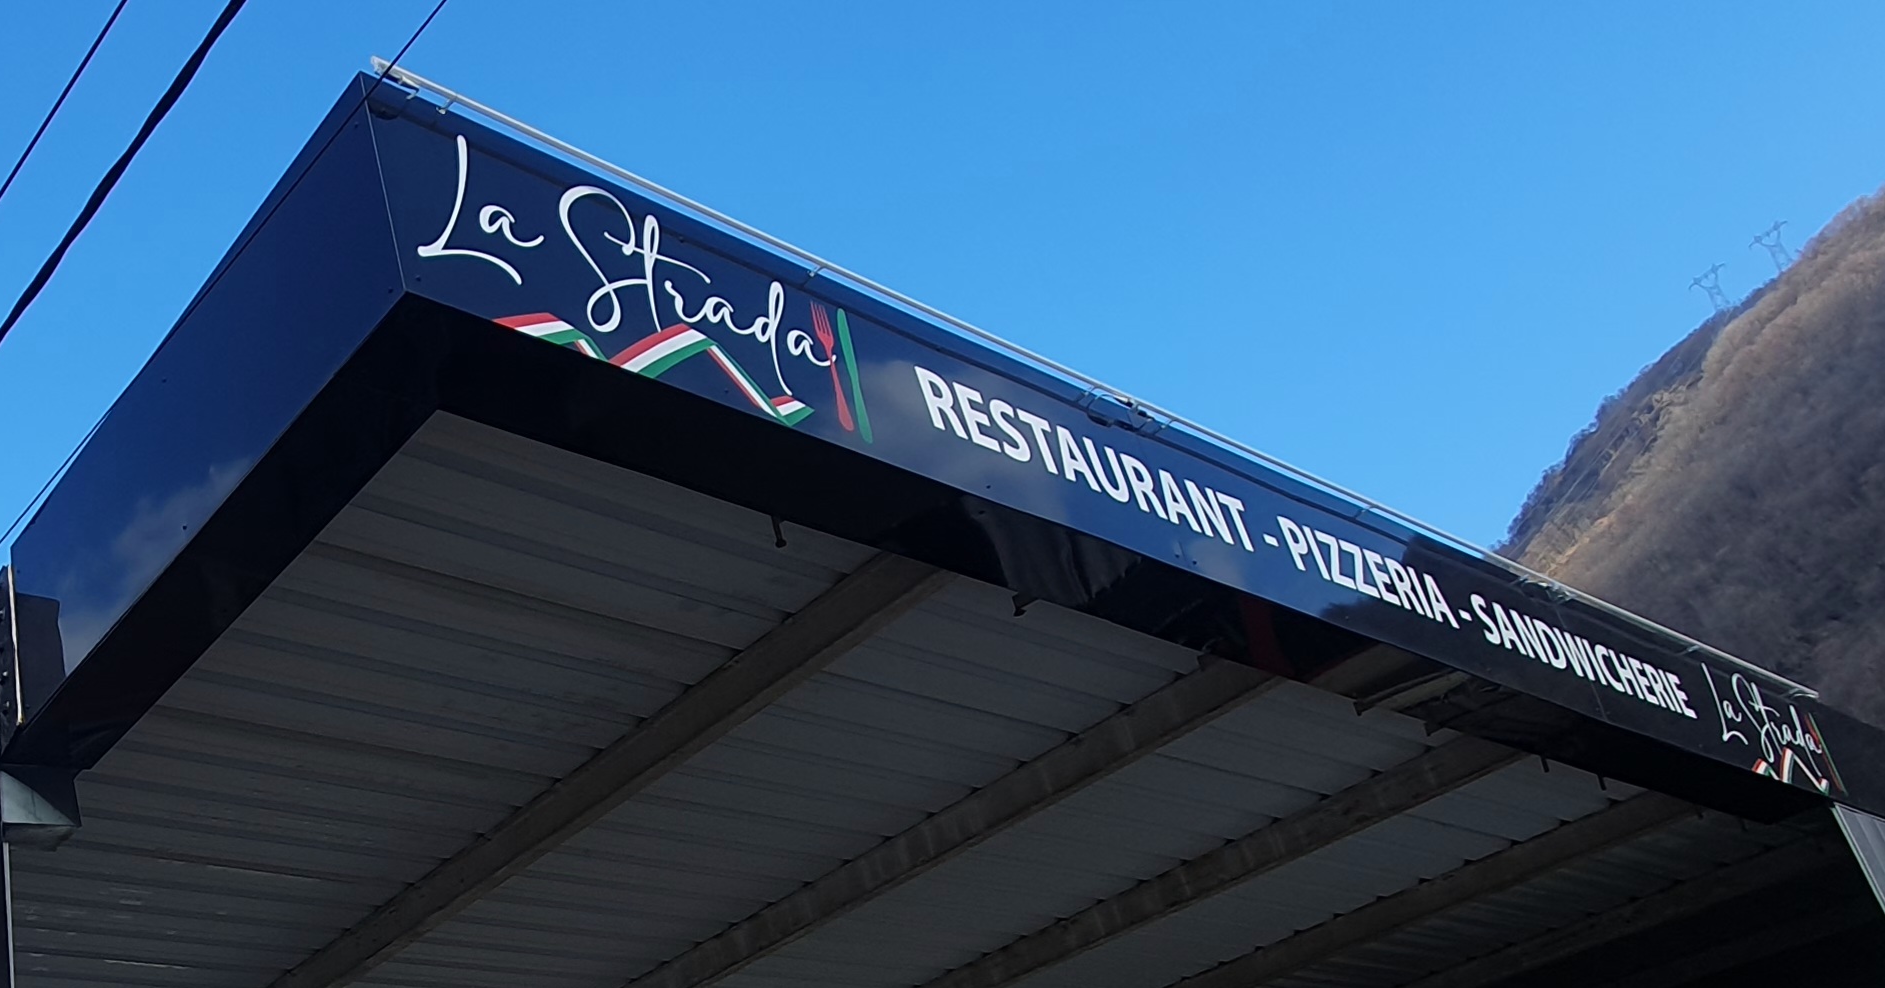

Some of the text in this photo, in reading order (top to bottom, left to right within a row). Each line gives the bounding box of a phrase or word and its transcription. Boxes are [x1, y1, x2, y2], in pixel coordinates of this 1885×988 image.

[416, 134, 837, 396] La Strada
[914, 364, 1256, 553] RESTAURANT
[1276, 514, 1461, 630] PIZZERIA
[1470, 593, 1698, 720] SANDWICHERIE
[1700, 661, 1823, 778] La Strada
